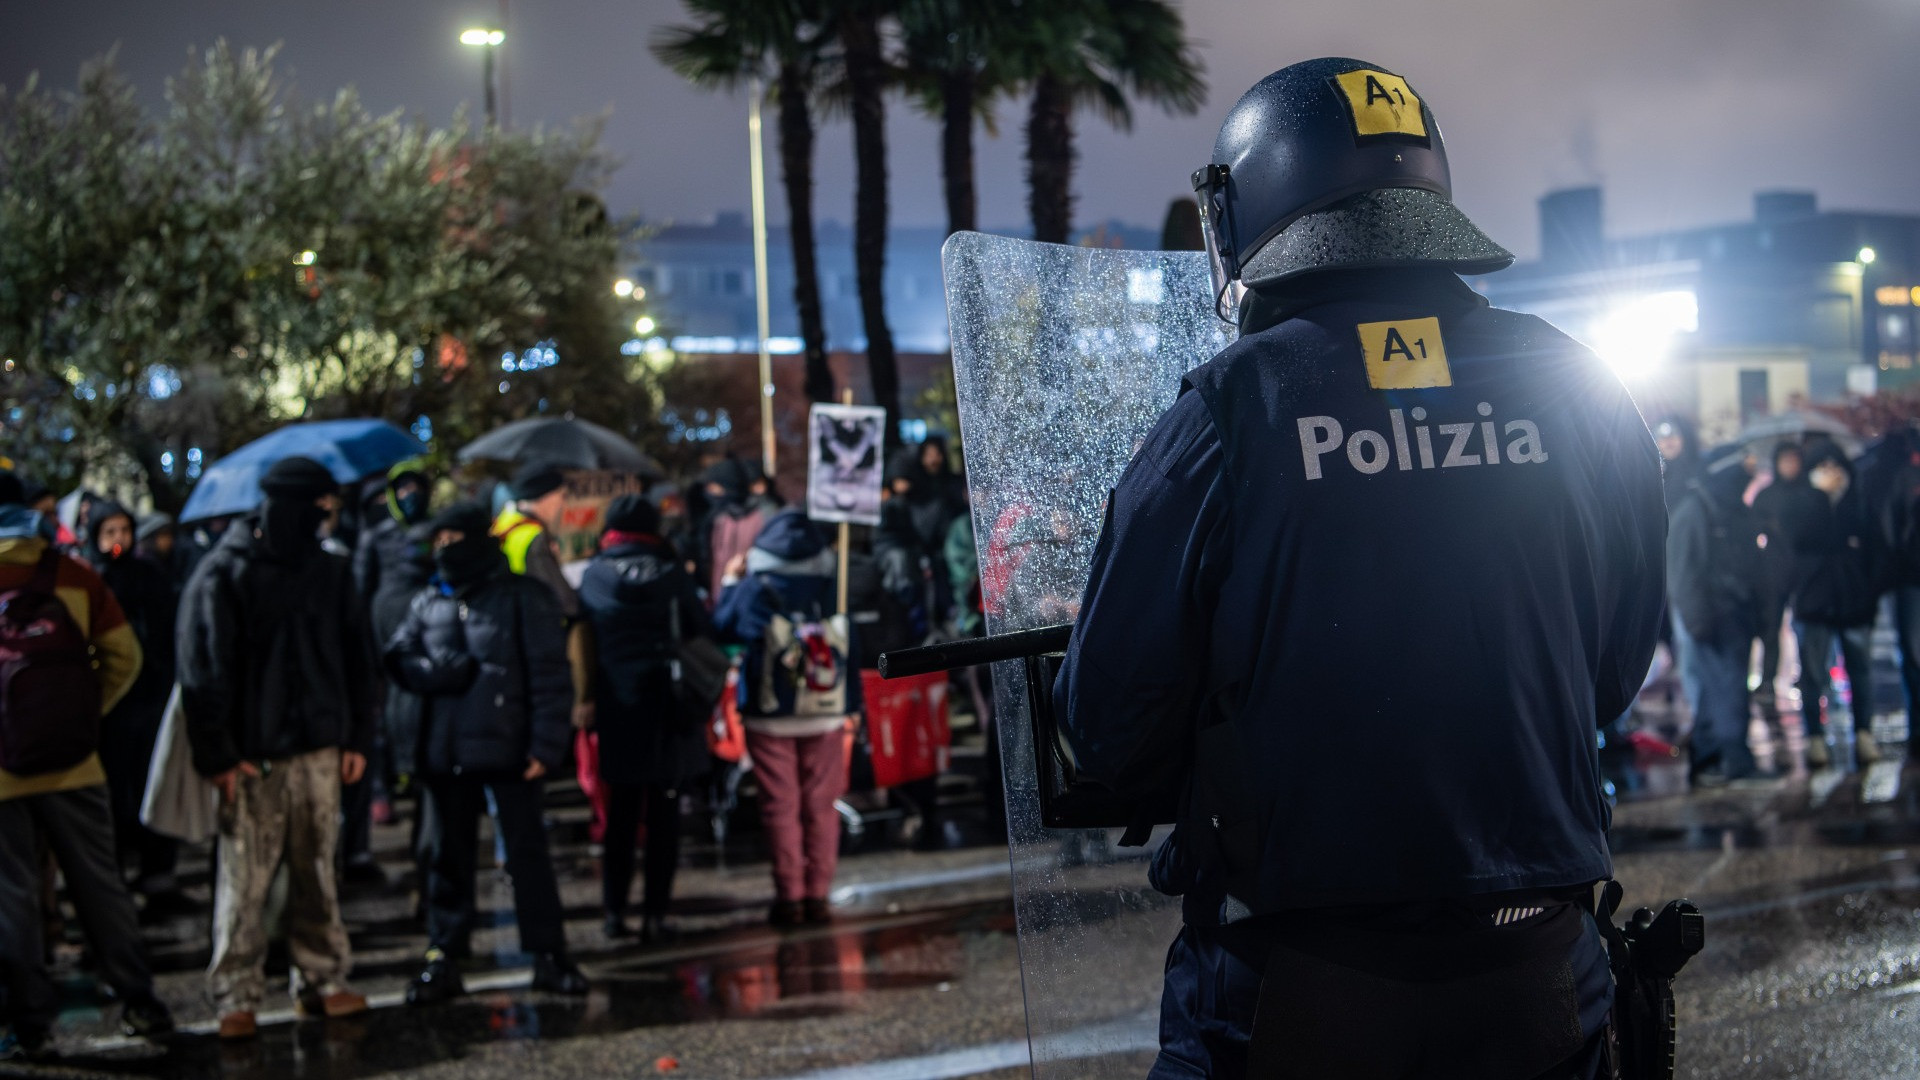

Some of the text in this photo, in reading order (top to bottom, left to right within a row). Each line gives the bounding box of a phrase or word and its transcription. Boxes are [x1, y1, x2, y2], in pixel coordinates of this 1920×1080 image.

[1366, 75, 1406, 106] A1
[1382, 327, 1428, 362] A1
[1297, 401, 1549, 480] Polizia
